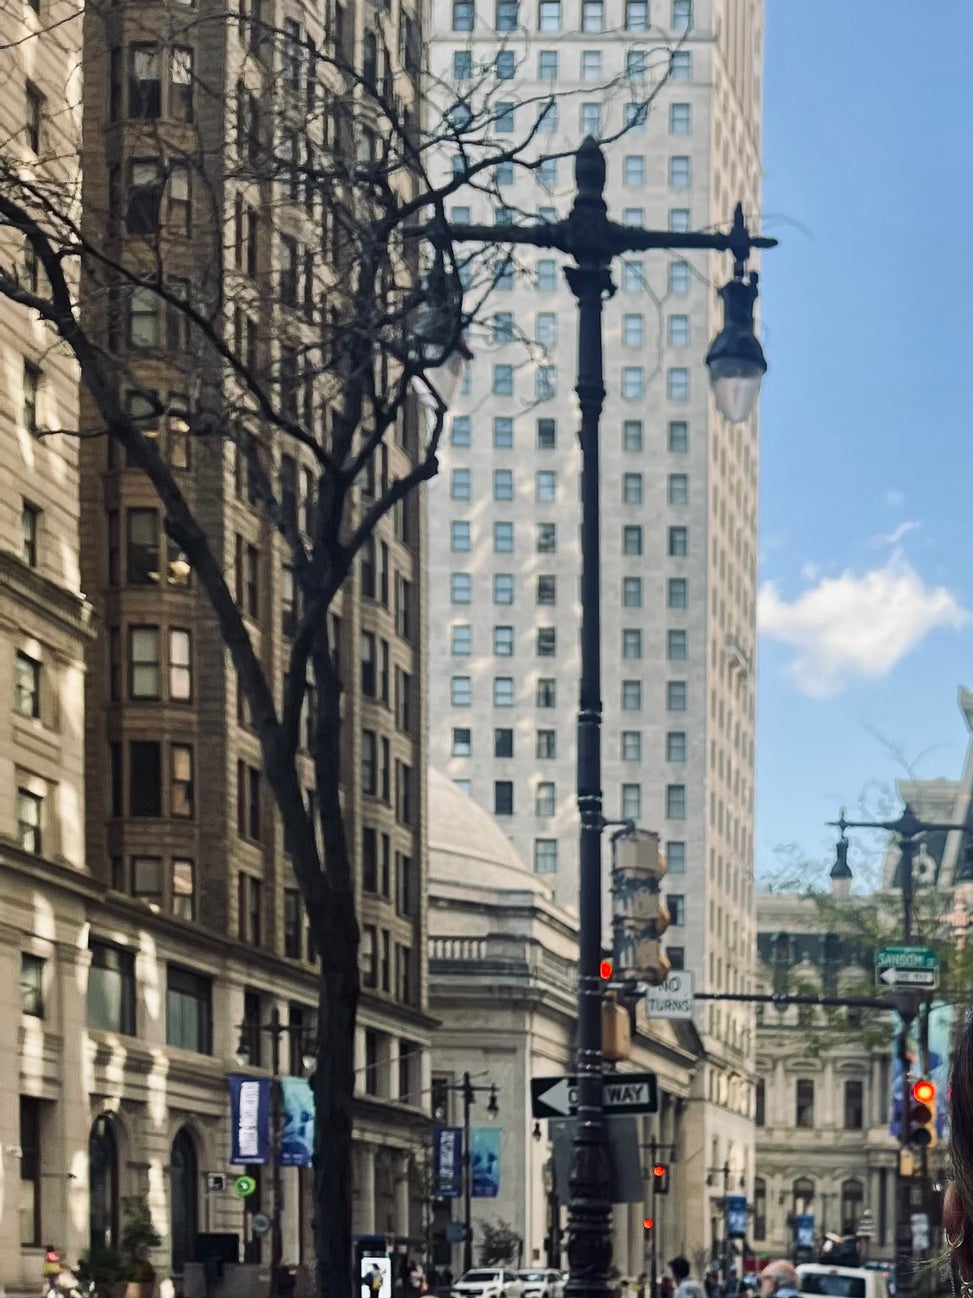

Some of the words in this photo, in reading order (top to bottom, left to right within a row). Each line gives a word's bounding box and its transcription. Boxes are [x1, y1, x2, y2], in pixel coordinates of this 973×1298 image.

[657, 976, 681, 993] NO
[649, 999, 691, 1012] TURNS
[607, 1084, 643, 1102] WAY
